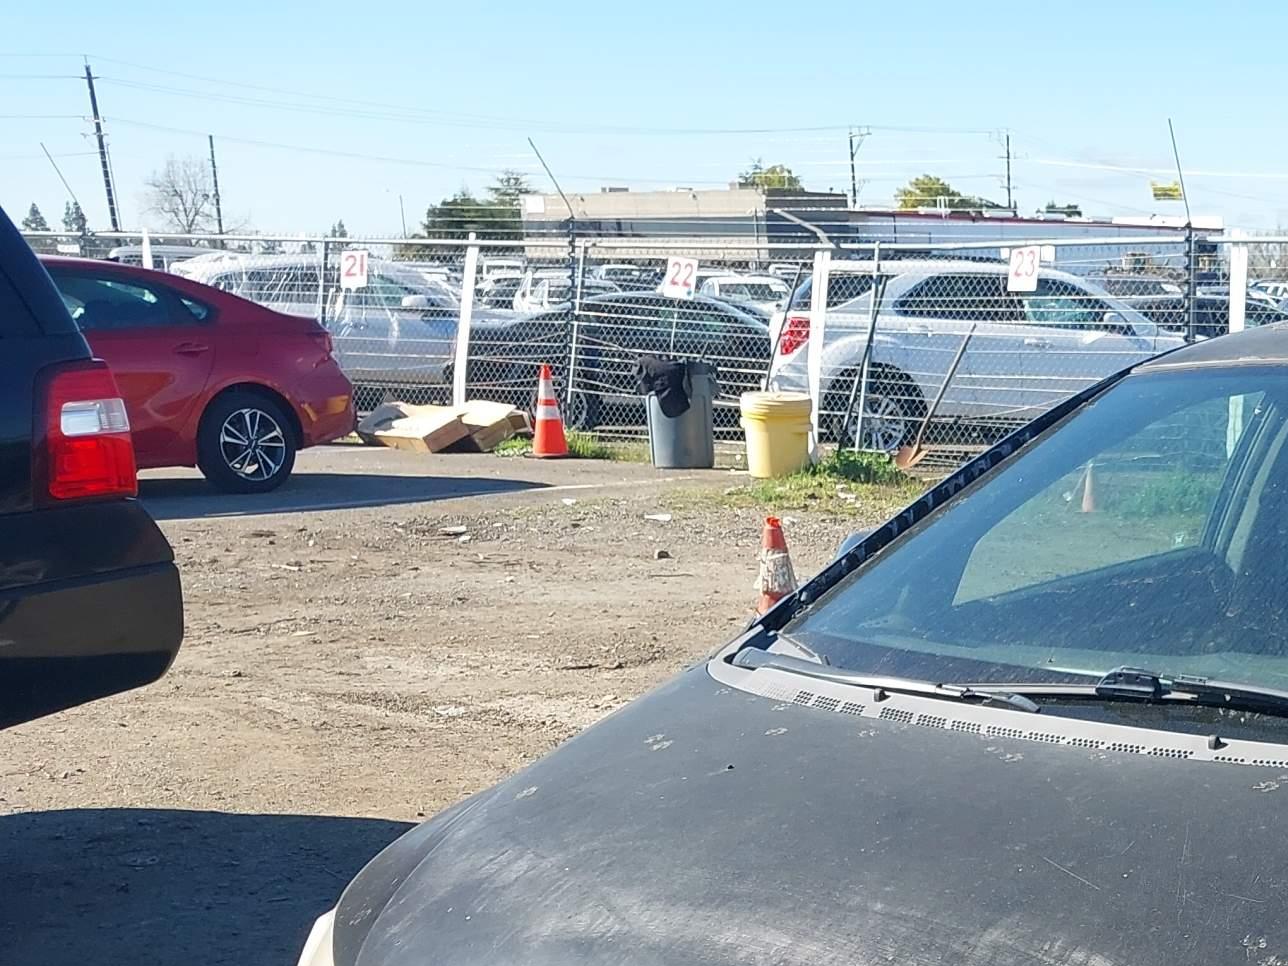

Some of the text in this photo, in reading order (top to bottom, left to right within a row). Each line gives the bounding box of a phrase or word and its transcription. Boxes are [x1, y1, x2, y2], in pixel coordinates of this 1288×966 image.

[344, 254, 364, 277] 21
[670, 261, 694, 288] 22
[1014, 250, 1036, 277] 23
